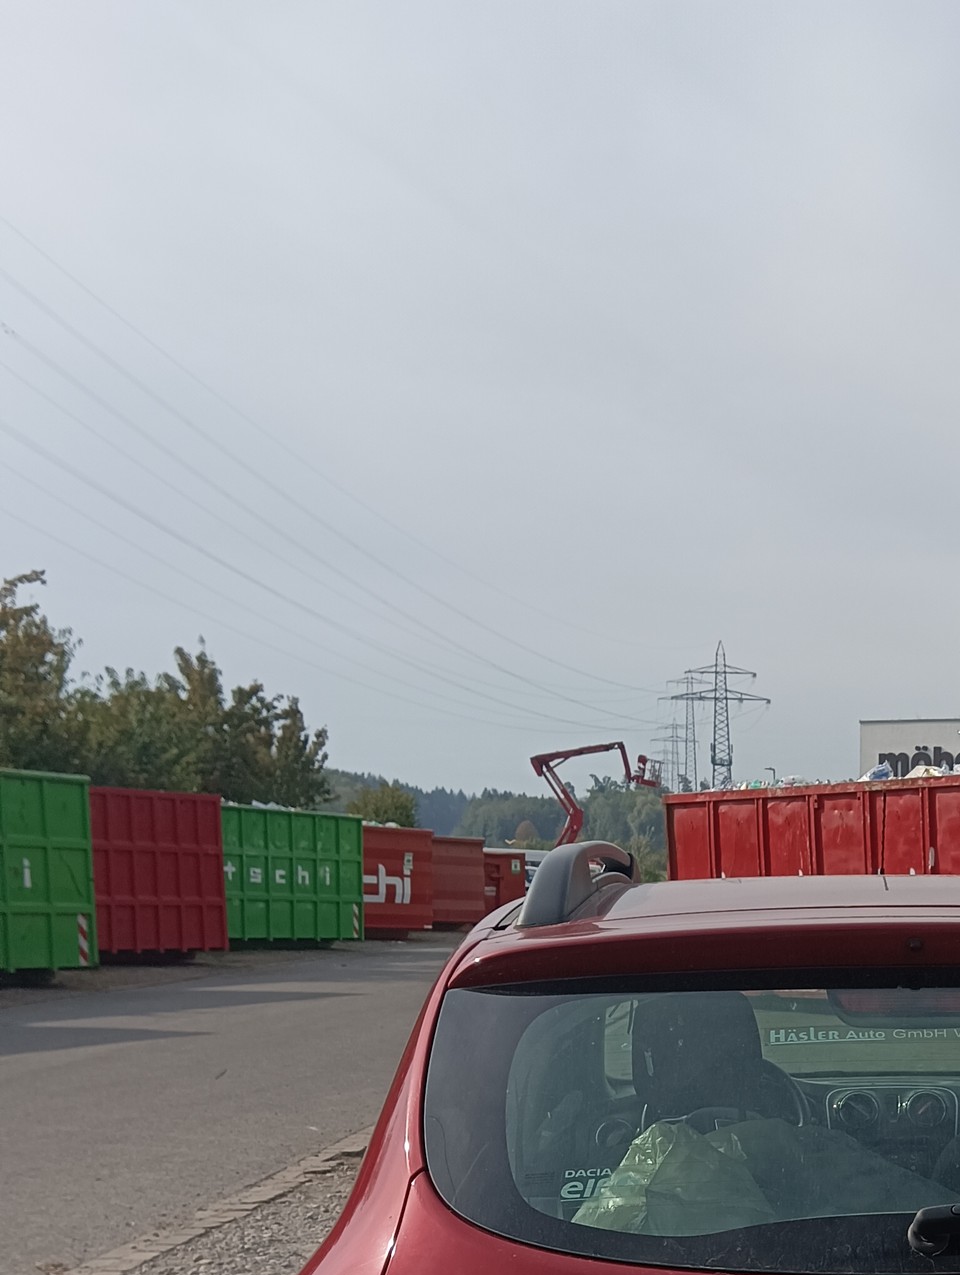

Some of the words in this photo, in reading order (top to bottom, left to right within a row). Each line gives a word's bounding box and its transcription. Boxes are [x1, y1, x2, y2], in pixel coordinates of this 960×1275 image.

[846, 1029, 886, 1040] Auto
[892, 1029, 947, 1039] GmbH
[564, 1168, 613, 1178] DACIA
